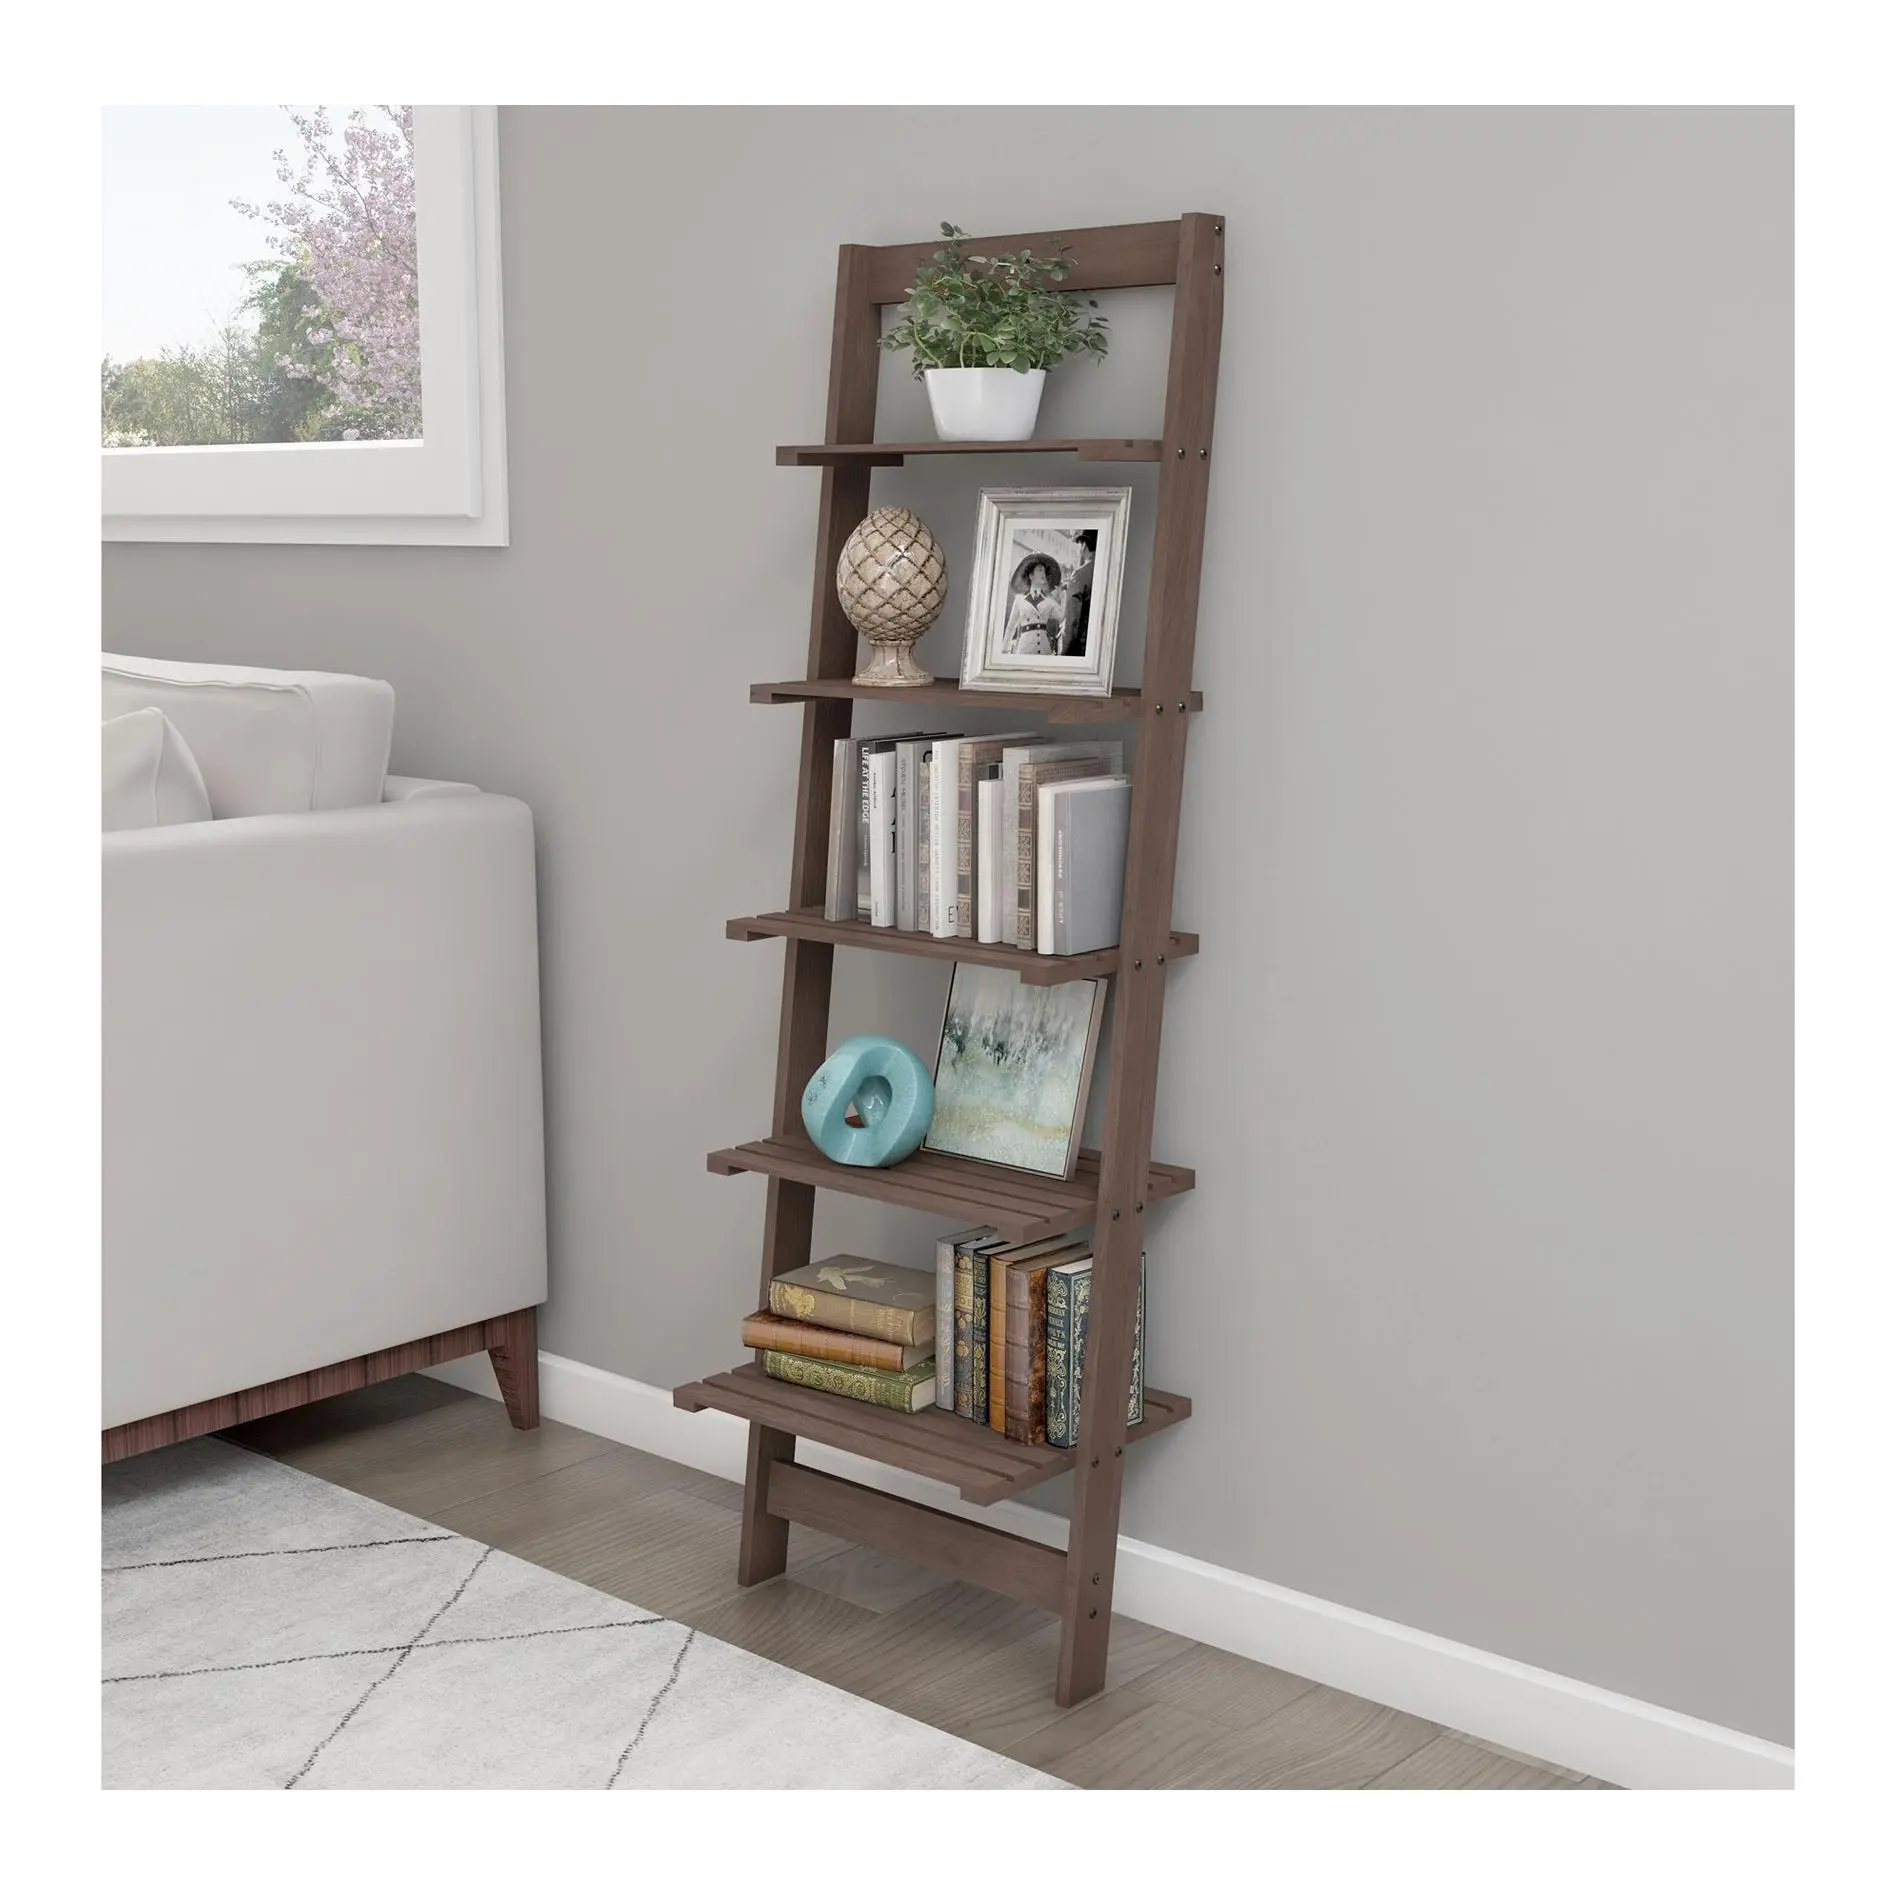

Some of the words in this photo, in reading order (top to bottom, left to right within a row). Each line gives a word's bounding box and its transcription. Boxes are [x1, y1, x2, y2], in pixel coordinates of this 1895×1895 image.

[861, 746, 869, 765] LIFE
[861, 766, 869, 779] AT
[862, 780, 870, 797] THE
[862, 799, 870, 824] EDGE
